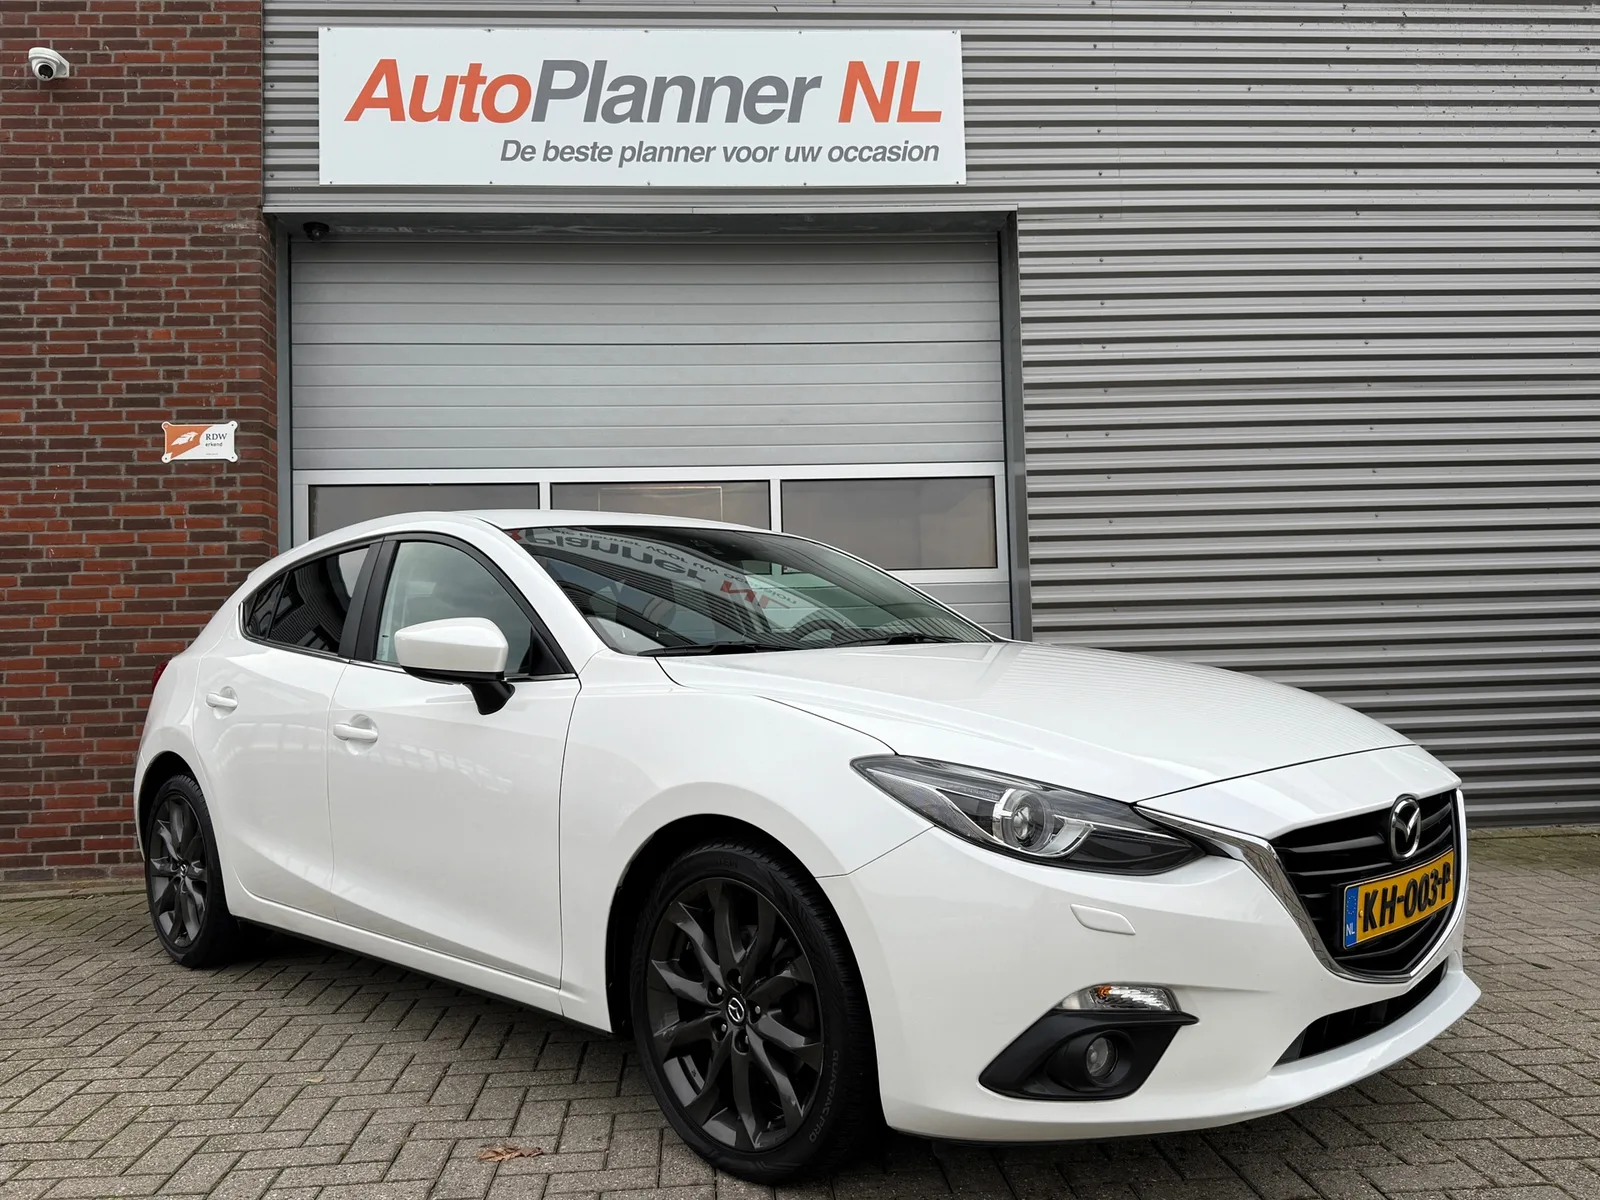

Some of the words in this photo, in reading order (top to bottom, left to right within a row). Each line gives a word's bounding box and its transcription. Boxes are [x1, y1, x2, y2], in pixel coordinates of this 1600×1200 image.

[344, 59, 822, 124] AutoPlanner
[837, 60, 943, 124] NL
[500, 139, 537, 162] De
[543, 139, 614, 163] beste
[618, 140, 717, 169] planner
[723, 145, 780, 164] voor
[785, 145, 823, 163] uw
[827, 139, 940, 163] occasion
[205, 432, 228, 441] RDW
[1362, 862, 1451, 933] KH-003-P
[1345, 922, 1356, 937] NL
